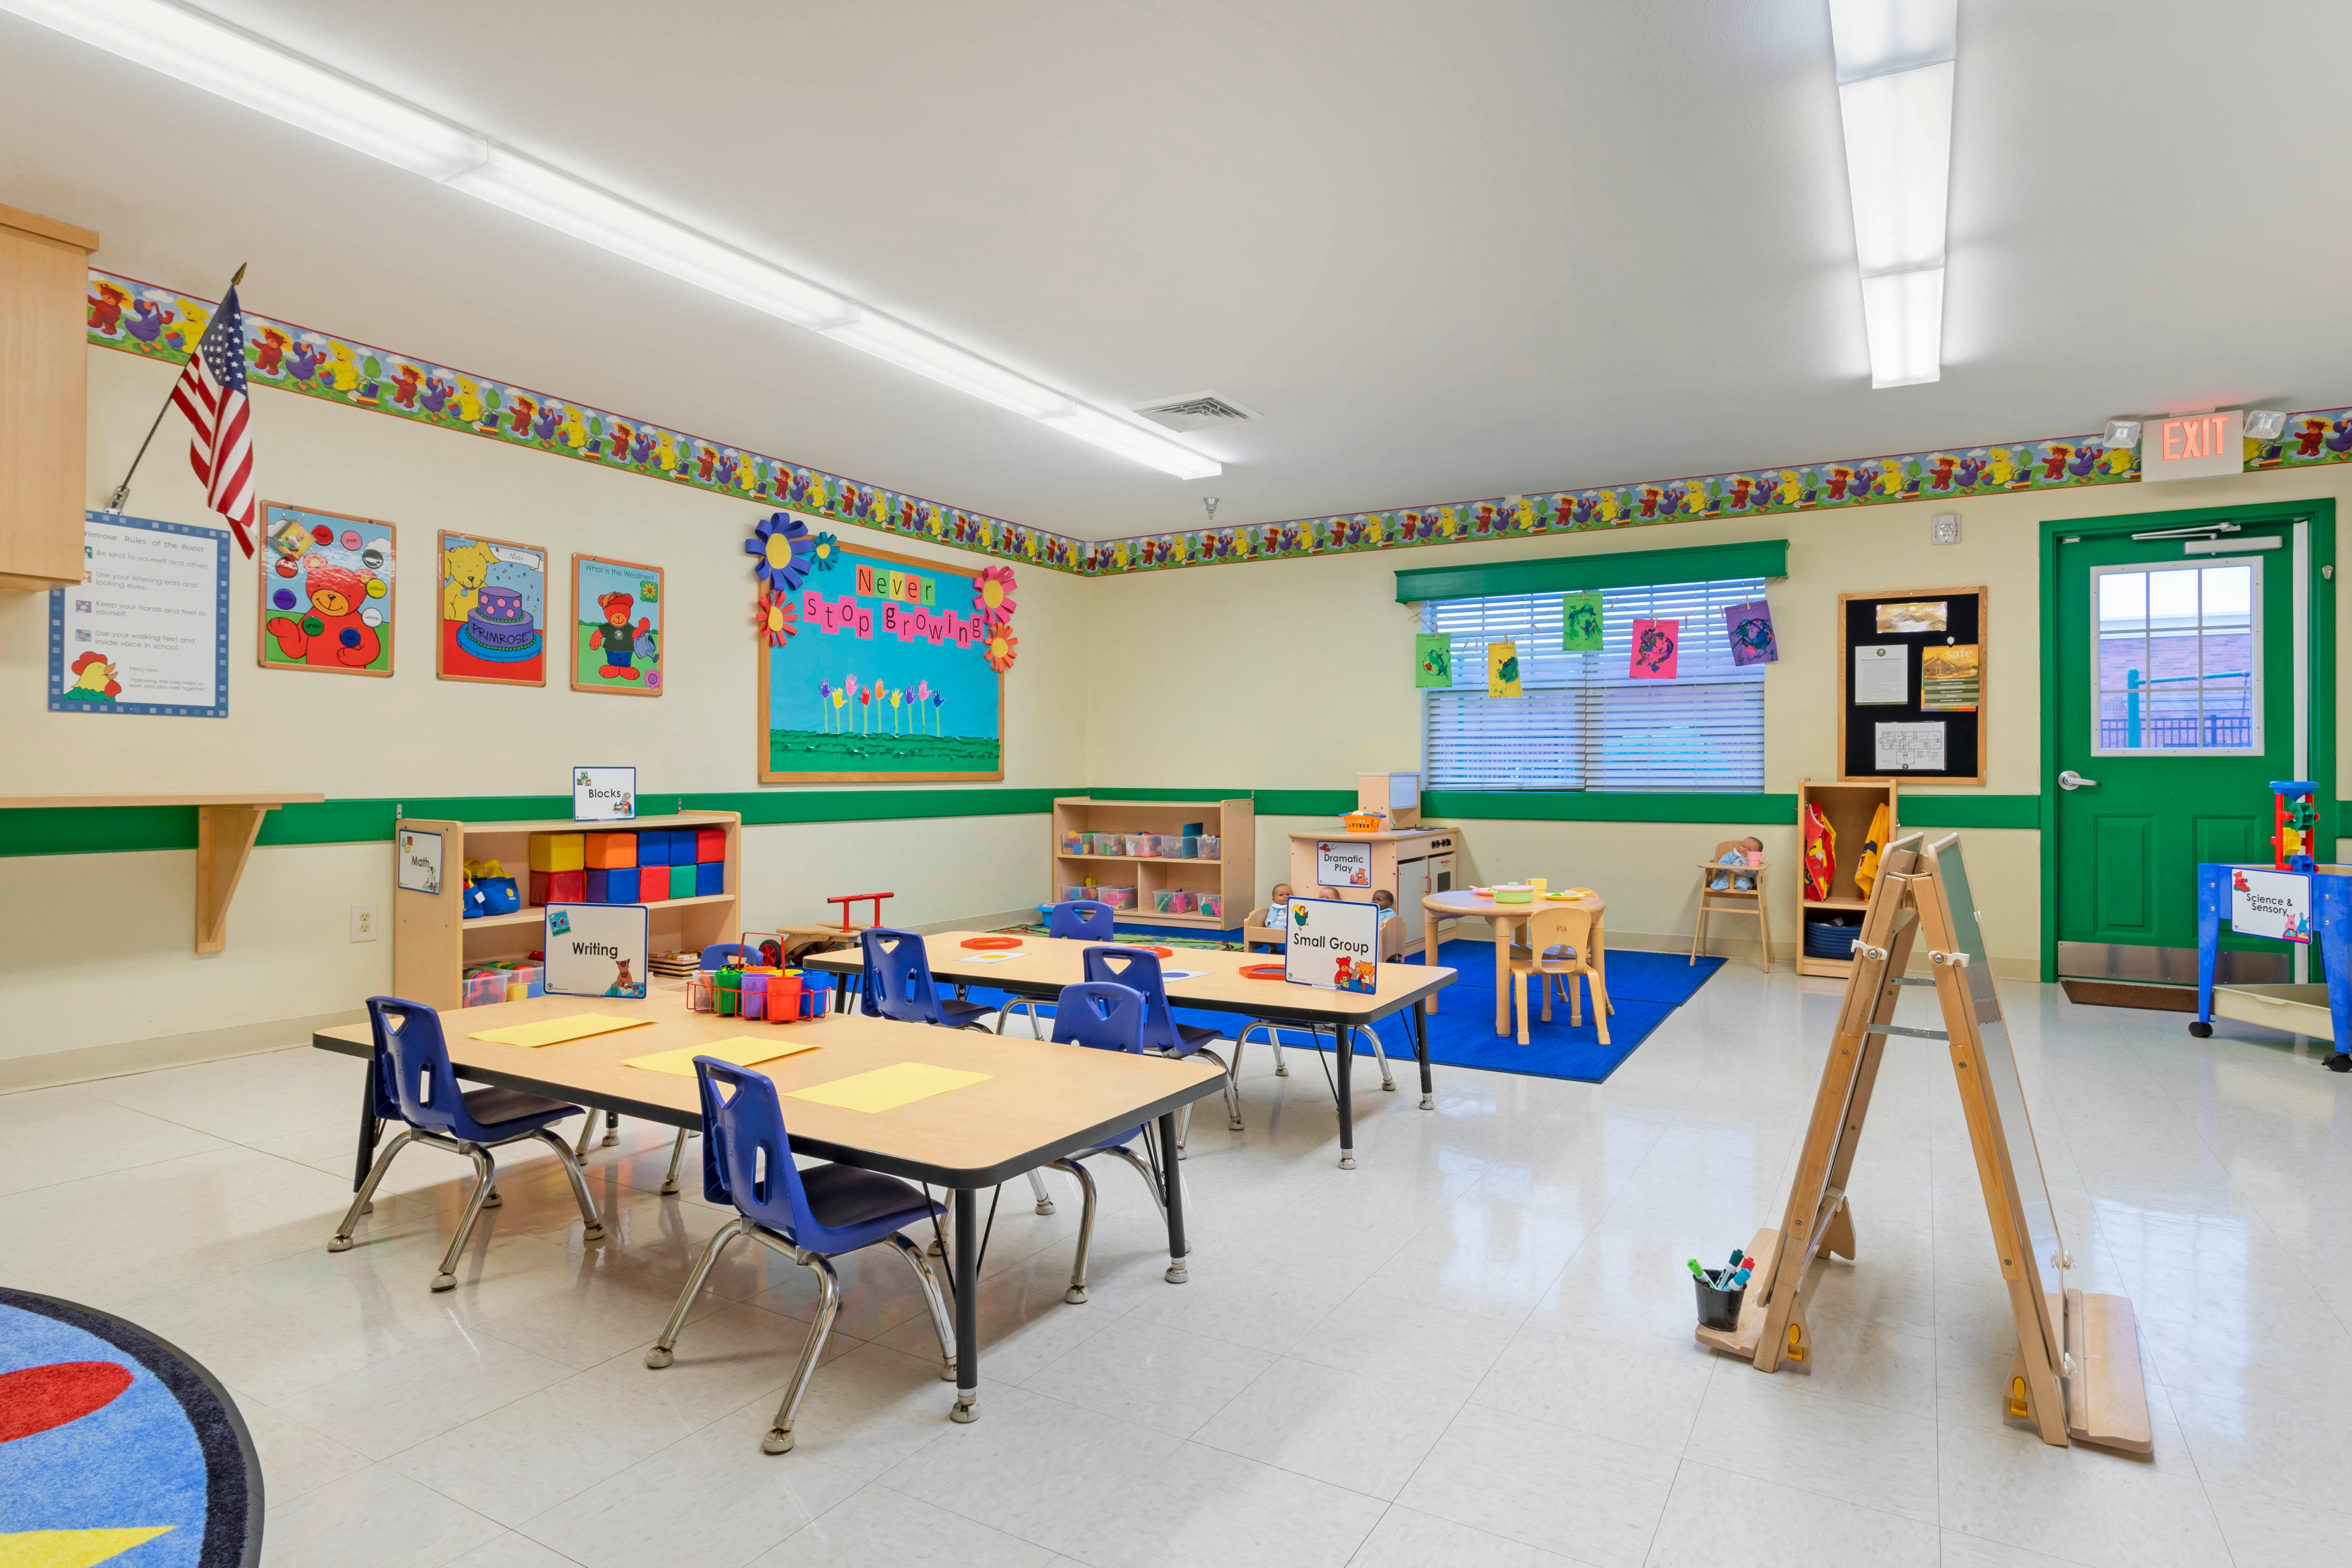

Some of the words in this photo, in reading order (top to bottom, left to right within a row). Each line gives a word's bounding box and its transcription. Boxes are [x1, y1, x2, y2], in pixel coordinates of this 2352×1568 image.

[2162, 416, 2228, 461] EXIT
[84, 531, 117, 541] rimrose
[124, 536, 147, 545] Rules
[182, 544, 204, 553] Roost
[138, 555, 167, 564] yourself
[509, 553, 524, 563] May
[585, 564, 603, 573] What
[624, 570, 654, 581] Weather?
[96, 579, 125, 589] looking
[132, 575, 162, 585] listening
[858, 569, 931, 600] Never
[96, 601, 117, 610] Keep
[886, 607, 981, 643] growing
[132, 633, 161, 642] walking
[1946, 648, 1973, 659] safe
[589, 789, 621, 798] Blocks
[411, 855, 429, 868] Math
[1324, 854, 1364, 863] Dramatic
[1335, 864, 1353, 874] Play
[2246, 893, 2284, 905] Science
[2286, 899, 2293, 907] &
[2252, 902, 2288, 917] Sensory
[1294, 933, 1325, 948] Small
[1329, 937, 1369, 956] Group
[572, 942, 618, 960] Writing
